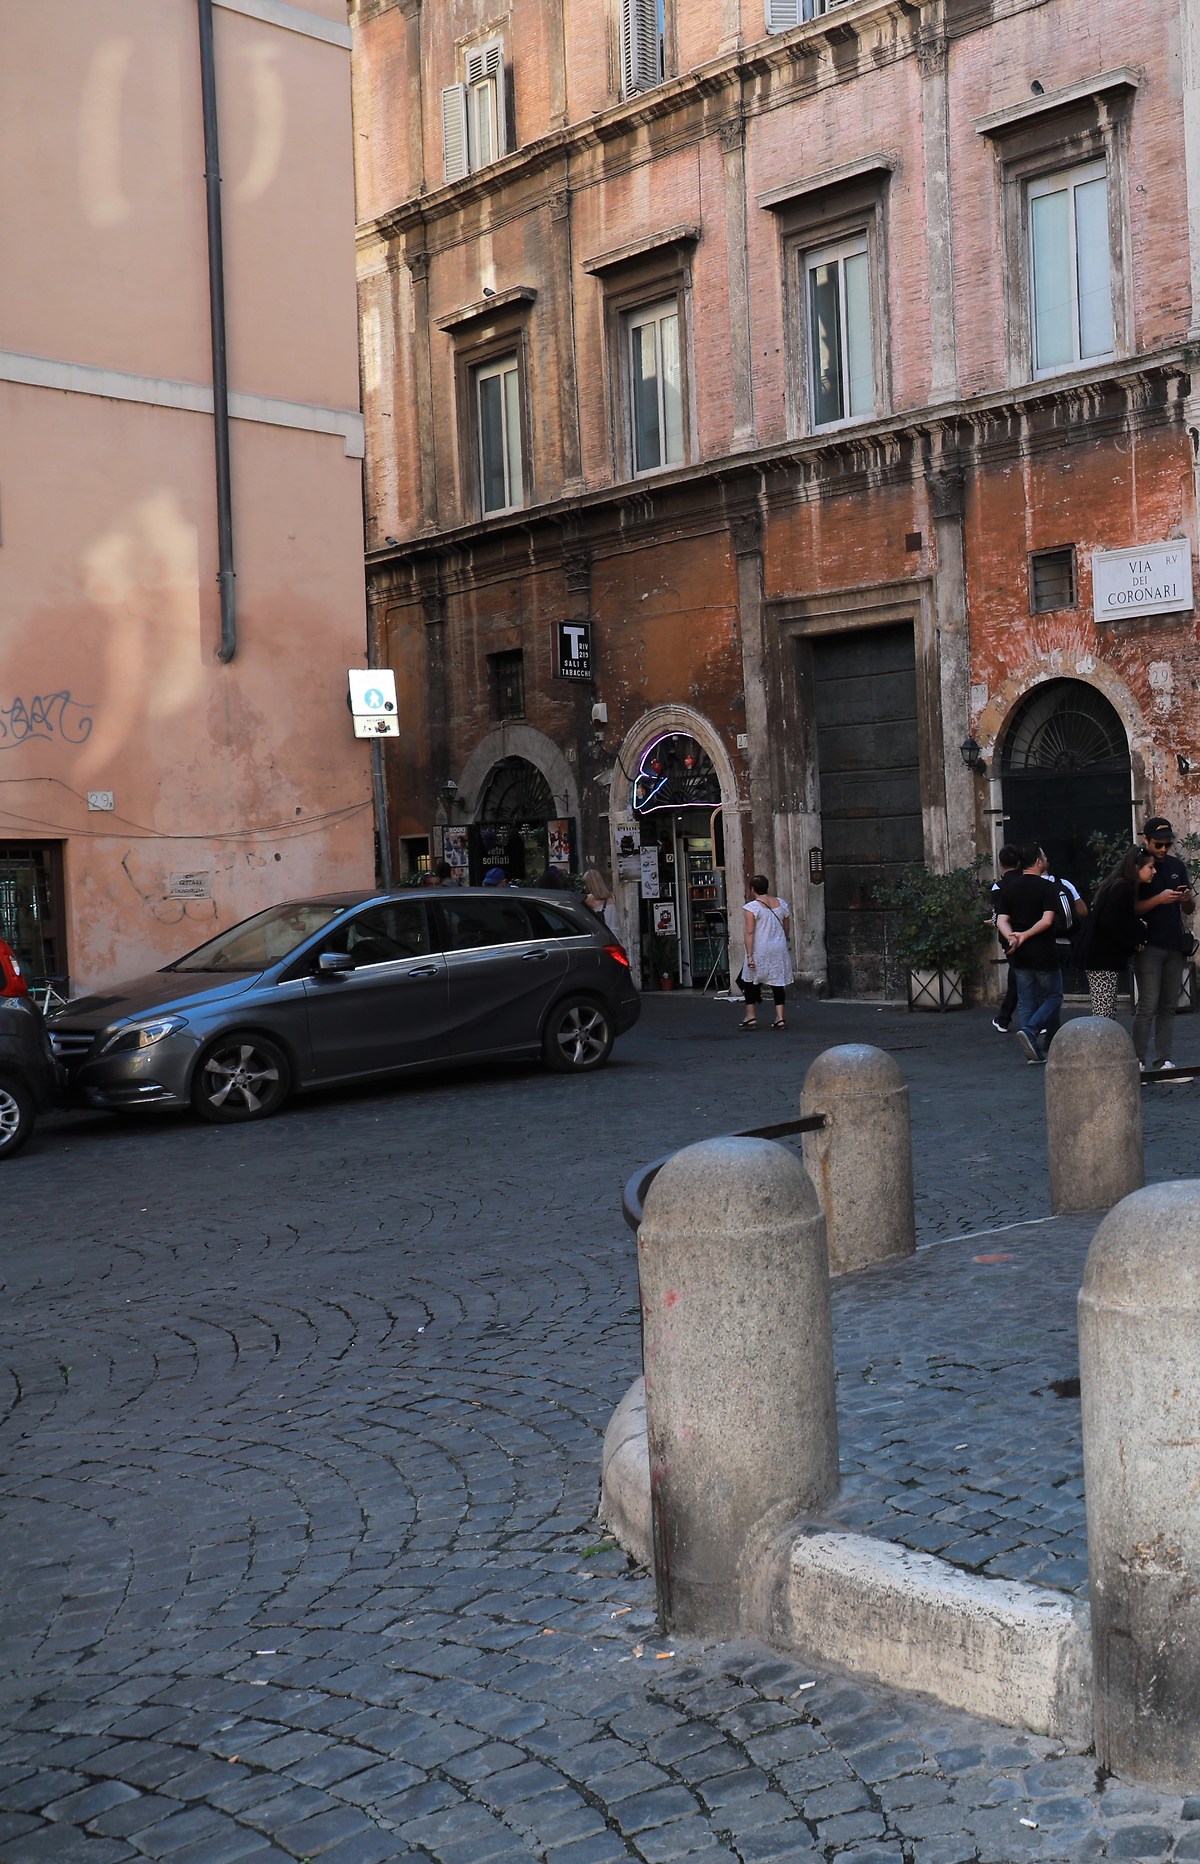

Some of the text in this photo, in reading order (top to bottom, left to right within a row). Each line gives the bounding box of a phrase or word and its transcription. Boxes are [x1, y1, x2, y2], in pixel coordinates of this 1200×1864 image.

[1129, 560, 1152, 573] VIA
[1132, 576, 1148, 586] DEI
[1108, 583, 1177, 605] CORONARI
[563, 626, 585, 659] T
[564, 660, 579, 668] SALI
[562, 668, 591, 677] TABACCHI
[1152, 669, 1169, 684] 29
